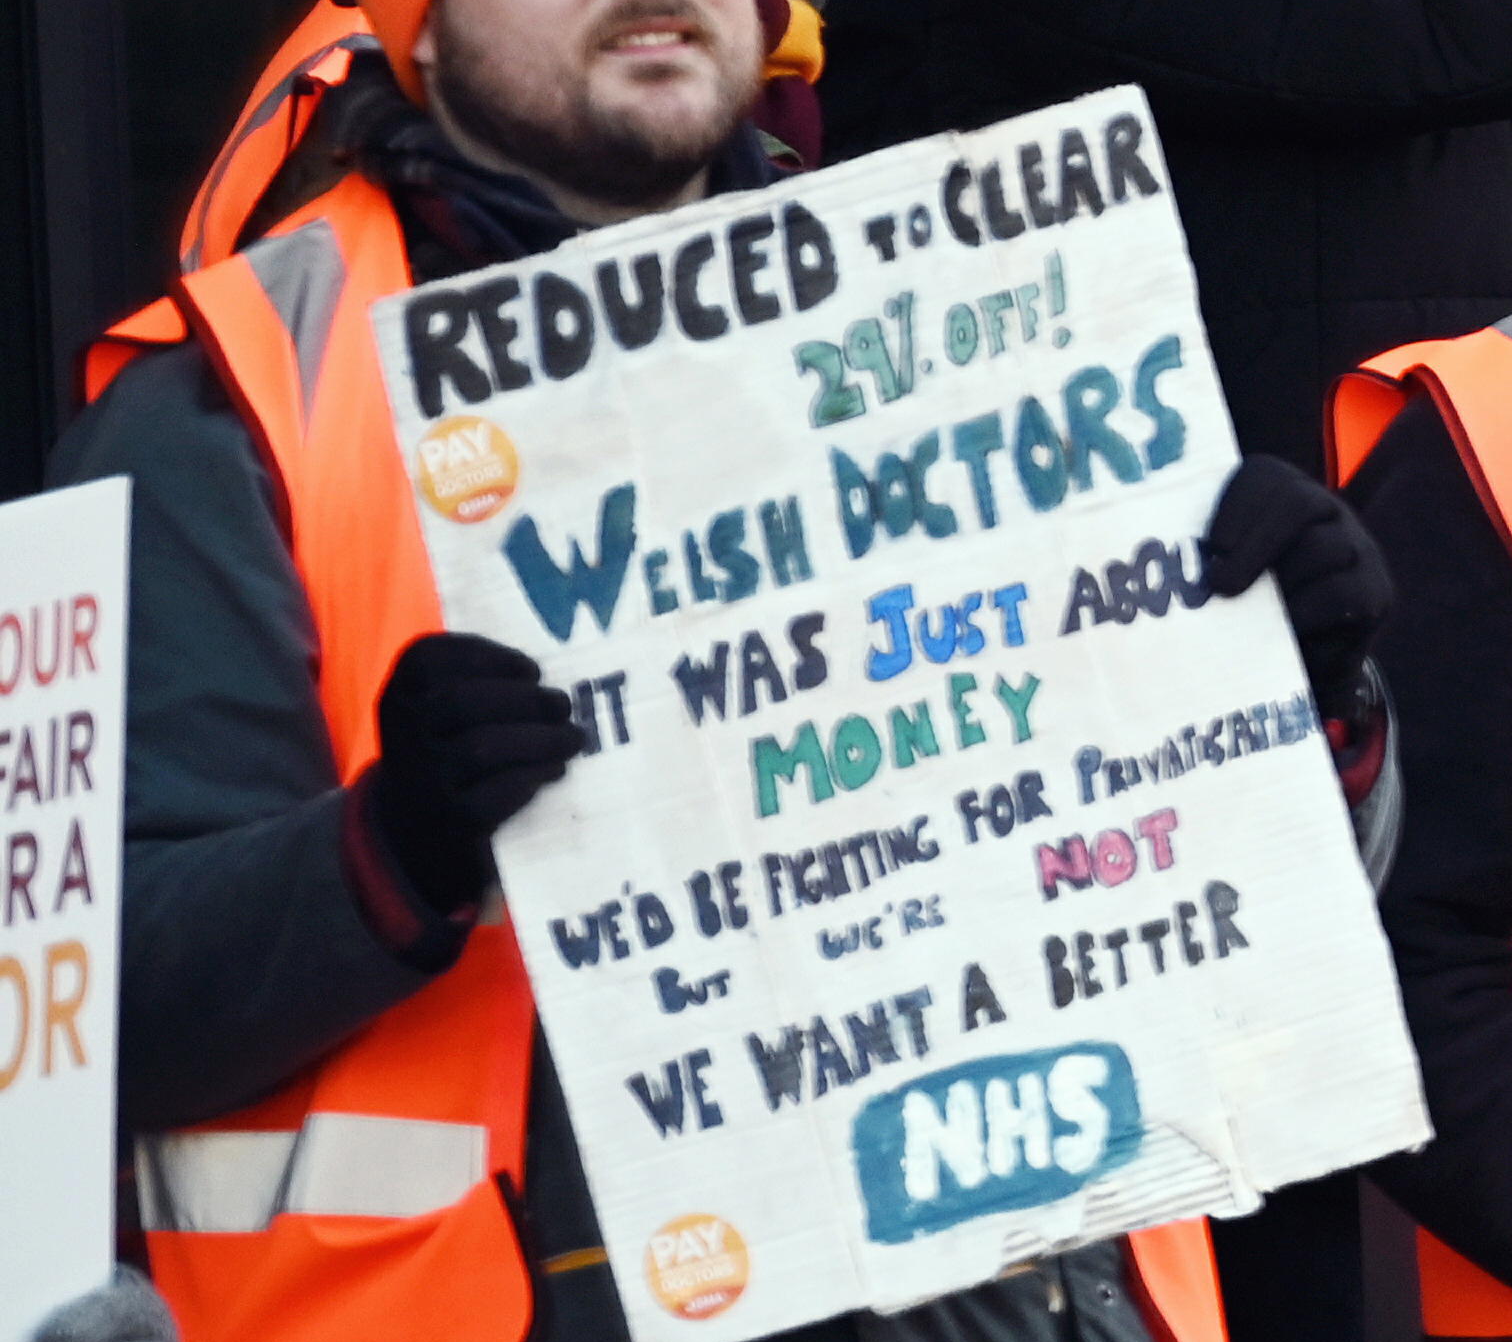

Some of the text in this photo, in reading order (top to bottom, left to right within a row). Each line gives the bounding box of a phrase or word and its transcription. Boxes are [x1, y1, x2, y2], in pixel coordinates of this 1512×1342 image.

[406, 200, 838, 419] REDUCED
[941, 112, 1163, 247] CLEAR
[943, 249, 1072, 369] OFF!
[420, 422, 489, 473] PAY
[501, 333, 1186, 643] WELSH DOCTORS
[672, 610, 830, 730] WAS
[865, 582, 1028, 682] JUST
[1060, 536, 1207, 638] ABOU
[751, 670, 1042, 820] MONEY
[52, 816, 94, 909] A
[548, 878, 675, 971] WE'D
[684, 858, 751, 940] BE
[767, 814, 941, 919] FIGHTING
[953, 768, 1056, 846] FOR
[650, 806, 1180, 1016] BUT WE'RE NOT
[624, 879, 1250, 1140] WE WANT A BETTER
[901, 1052, 1110, 1202] NHS
[649, 1220, 721, 1271] PAY
